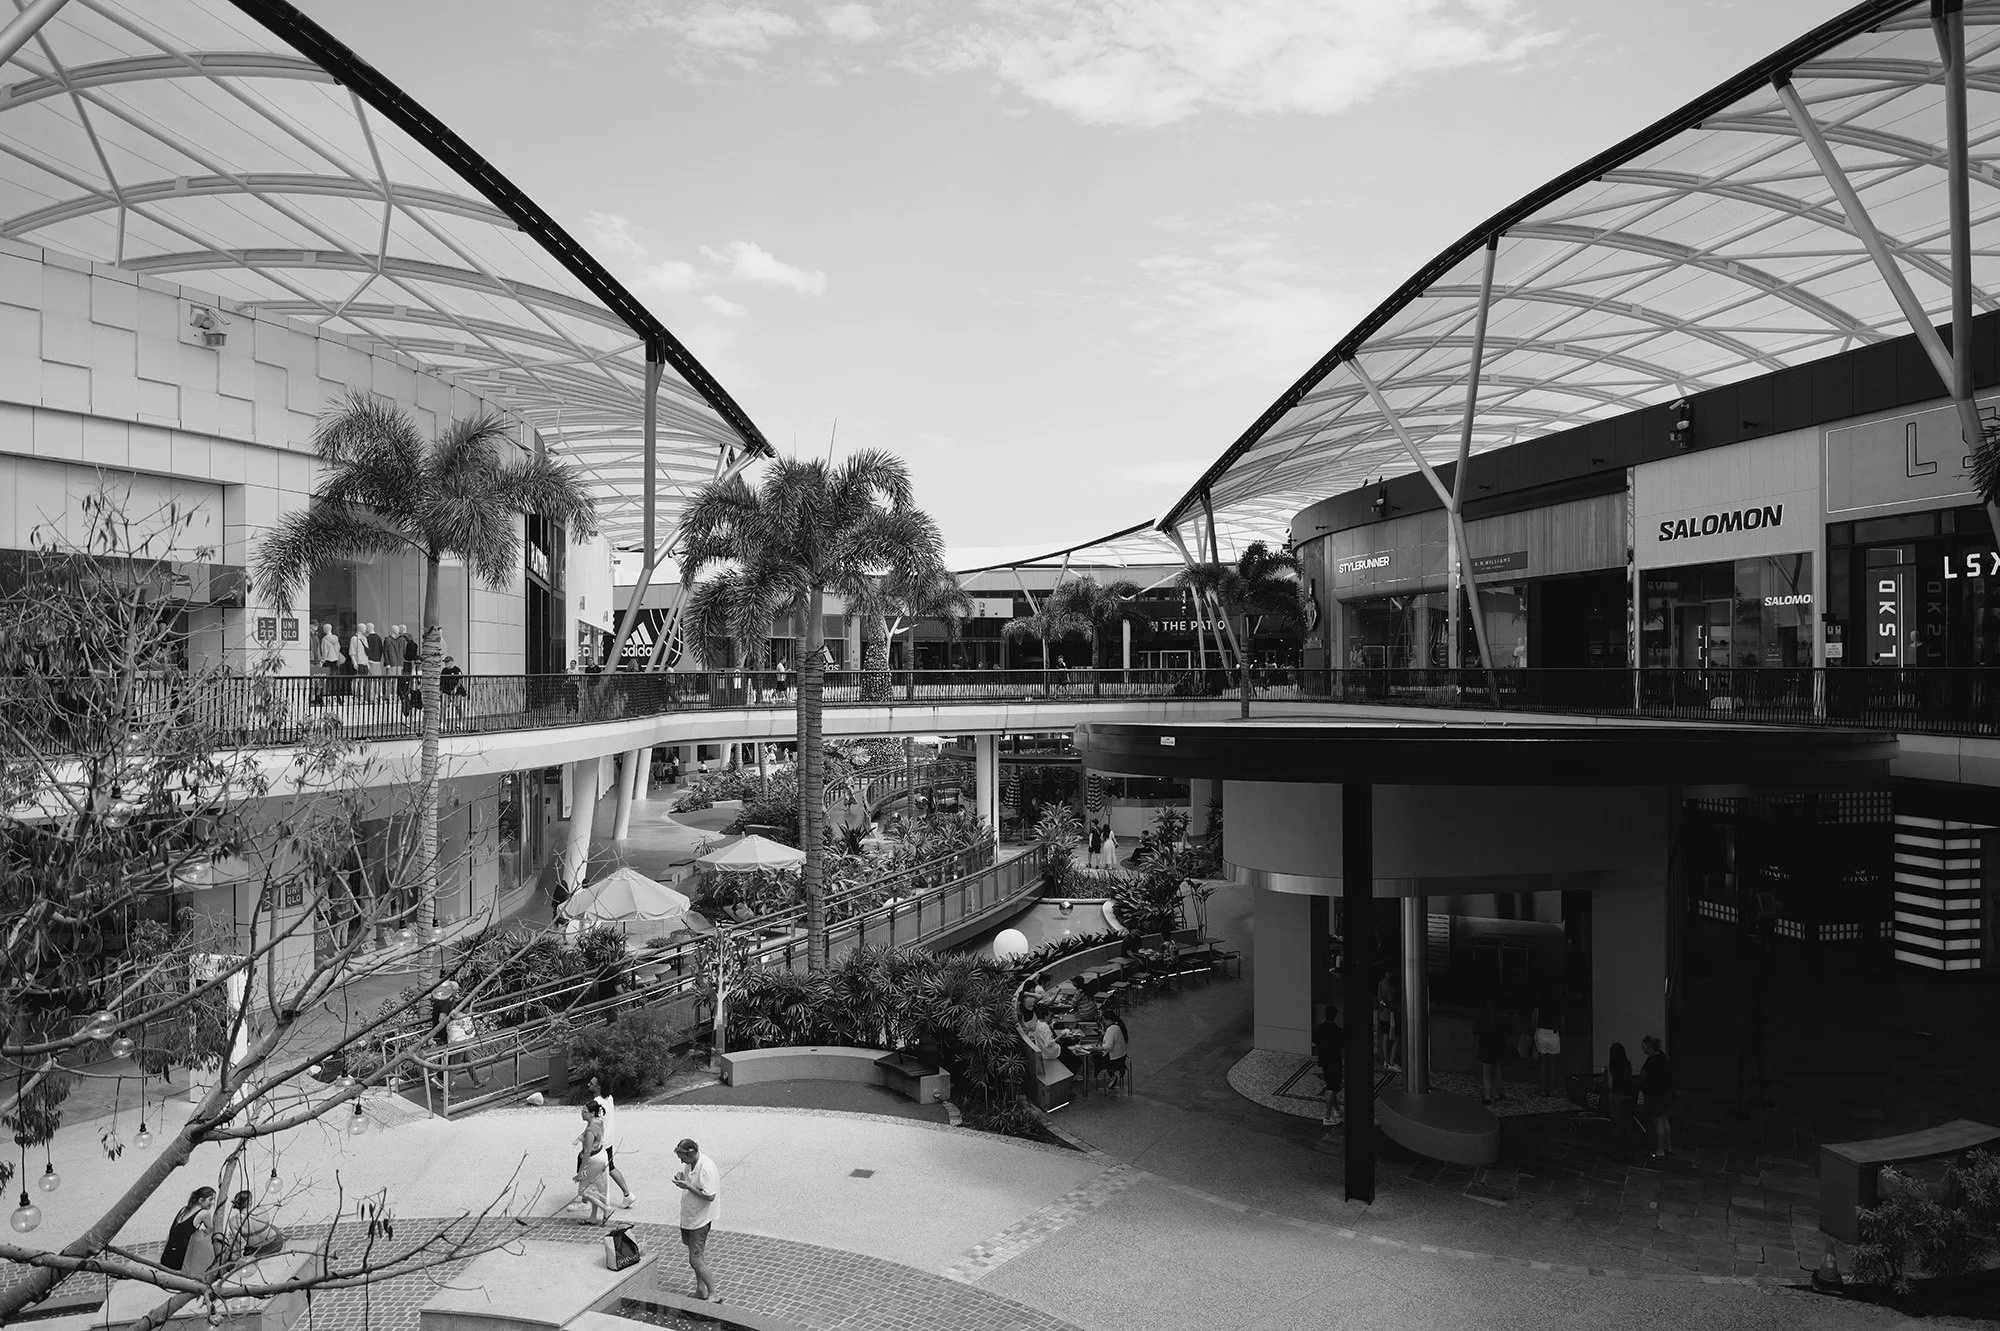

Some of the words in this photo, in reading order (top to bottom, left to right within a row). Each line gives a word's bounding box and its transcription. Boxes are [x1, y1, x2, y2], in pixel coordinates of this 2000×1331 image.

[1658, 503, 1784, 542] SALOMON
[1338, 556, 1390, 574] STYLERUNNER
[1764, 594, 1813, 607] SALOMO
[283, 621, 296, 629] UNI
[1879, 580, 1896, 657] LSKD
[1162, 620, 1187, 631] THE
[283, 630, 297, 640] QLO
